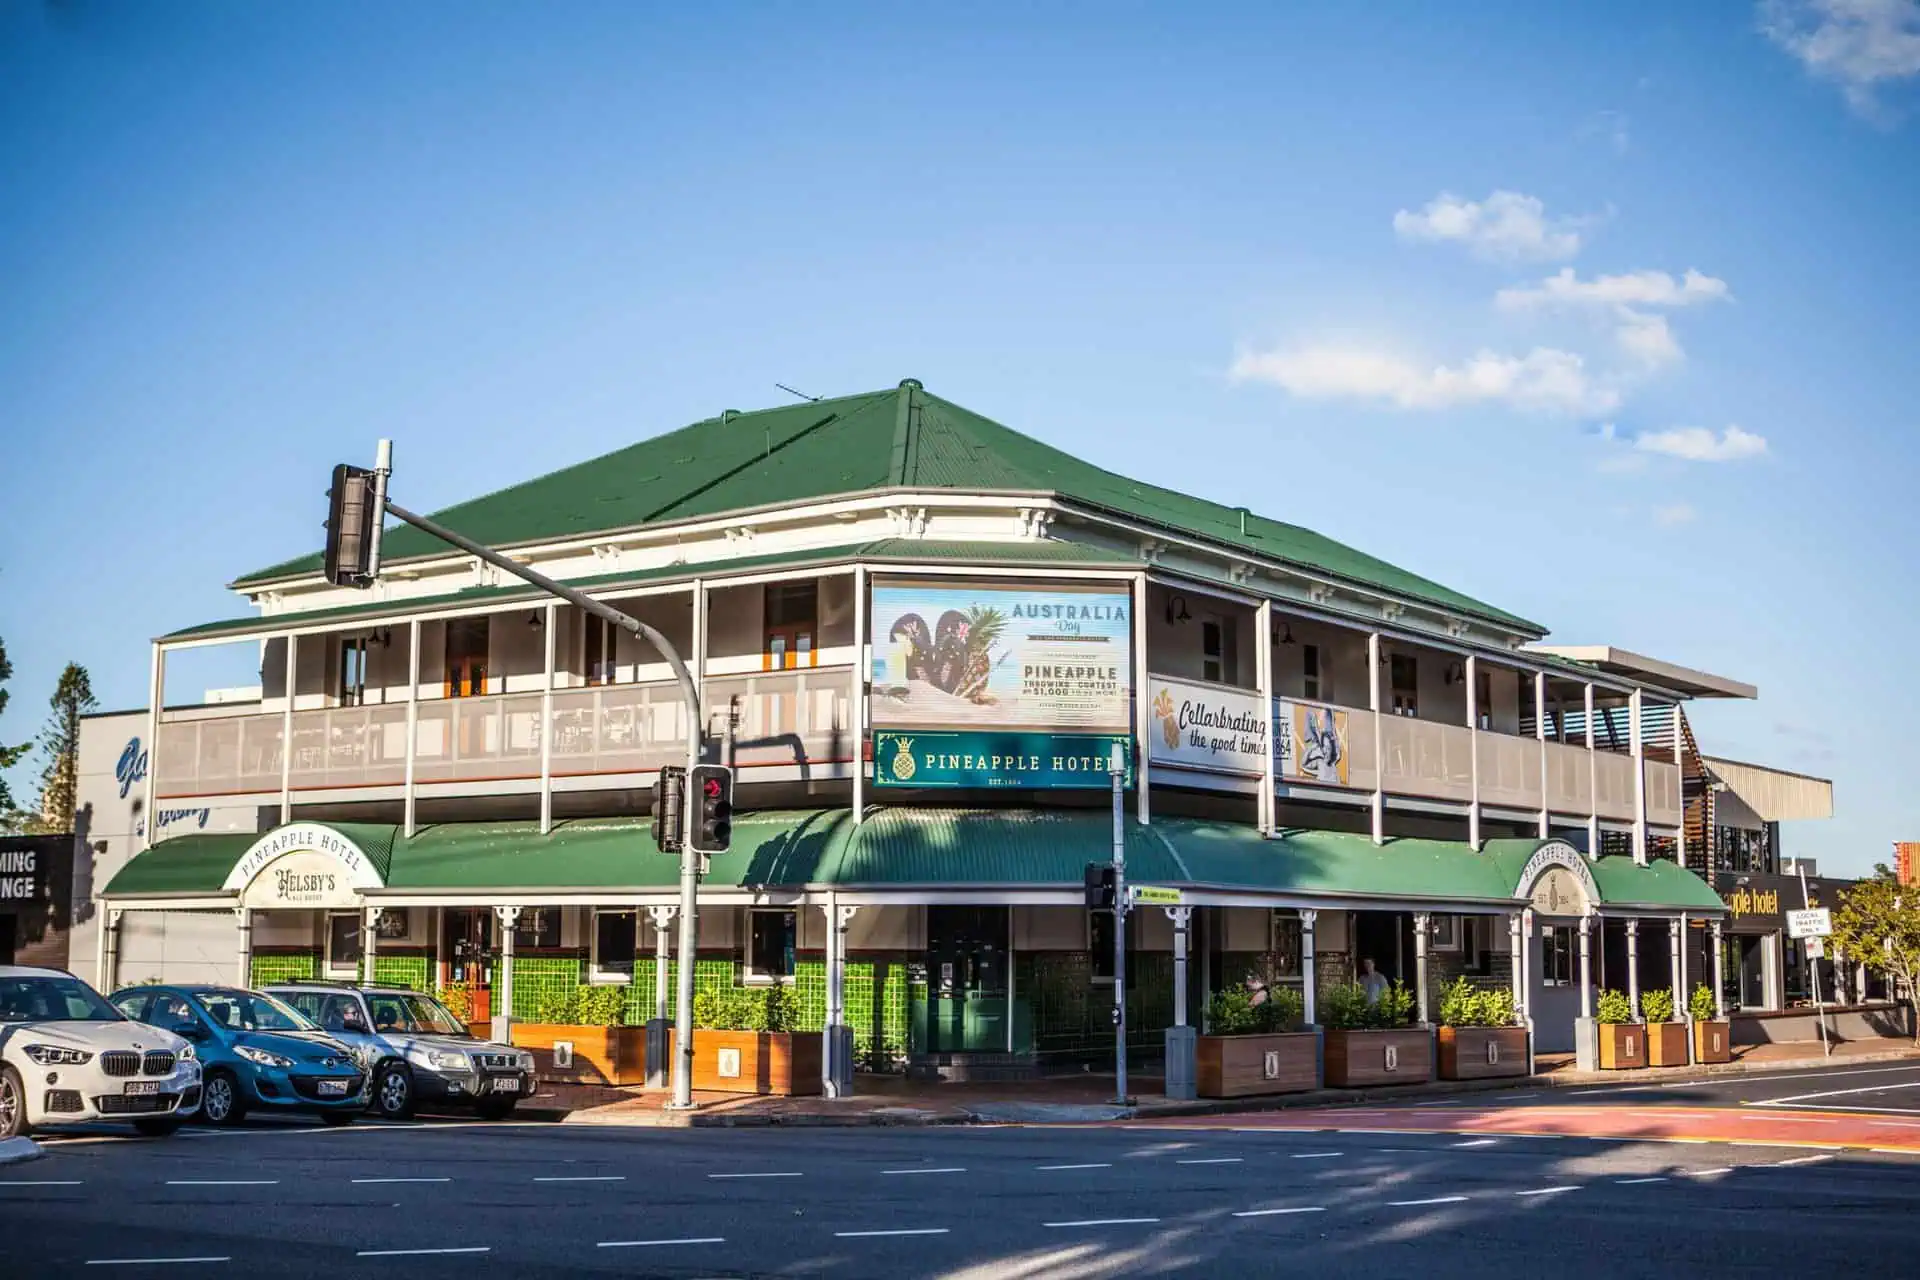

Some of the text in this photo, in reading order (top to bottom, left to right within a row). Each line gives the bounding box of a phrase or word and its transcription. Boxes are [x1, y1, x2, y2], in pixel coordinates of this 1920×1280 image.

[1012, 604, 1125, 620] AUSTRALIA
[1056, 620, 1081, 634] Day
[1024, 665, 1117, 680] PINEAPPLE
[1179, 700, 1266, 741] Cellarbrating
[1189, 730, 1266, 756] the good times
[926, 754, 1040, 770] PINEAPPLE
[242, 831, 360, 877] PINEAPPLE HOTEL
[1752, 888, 1778, 914] hotel
